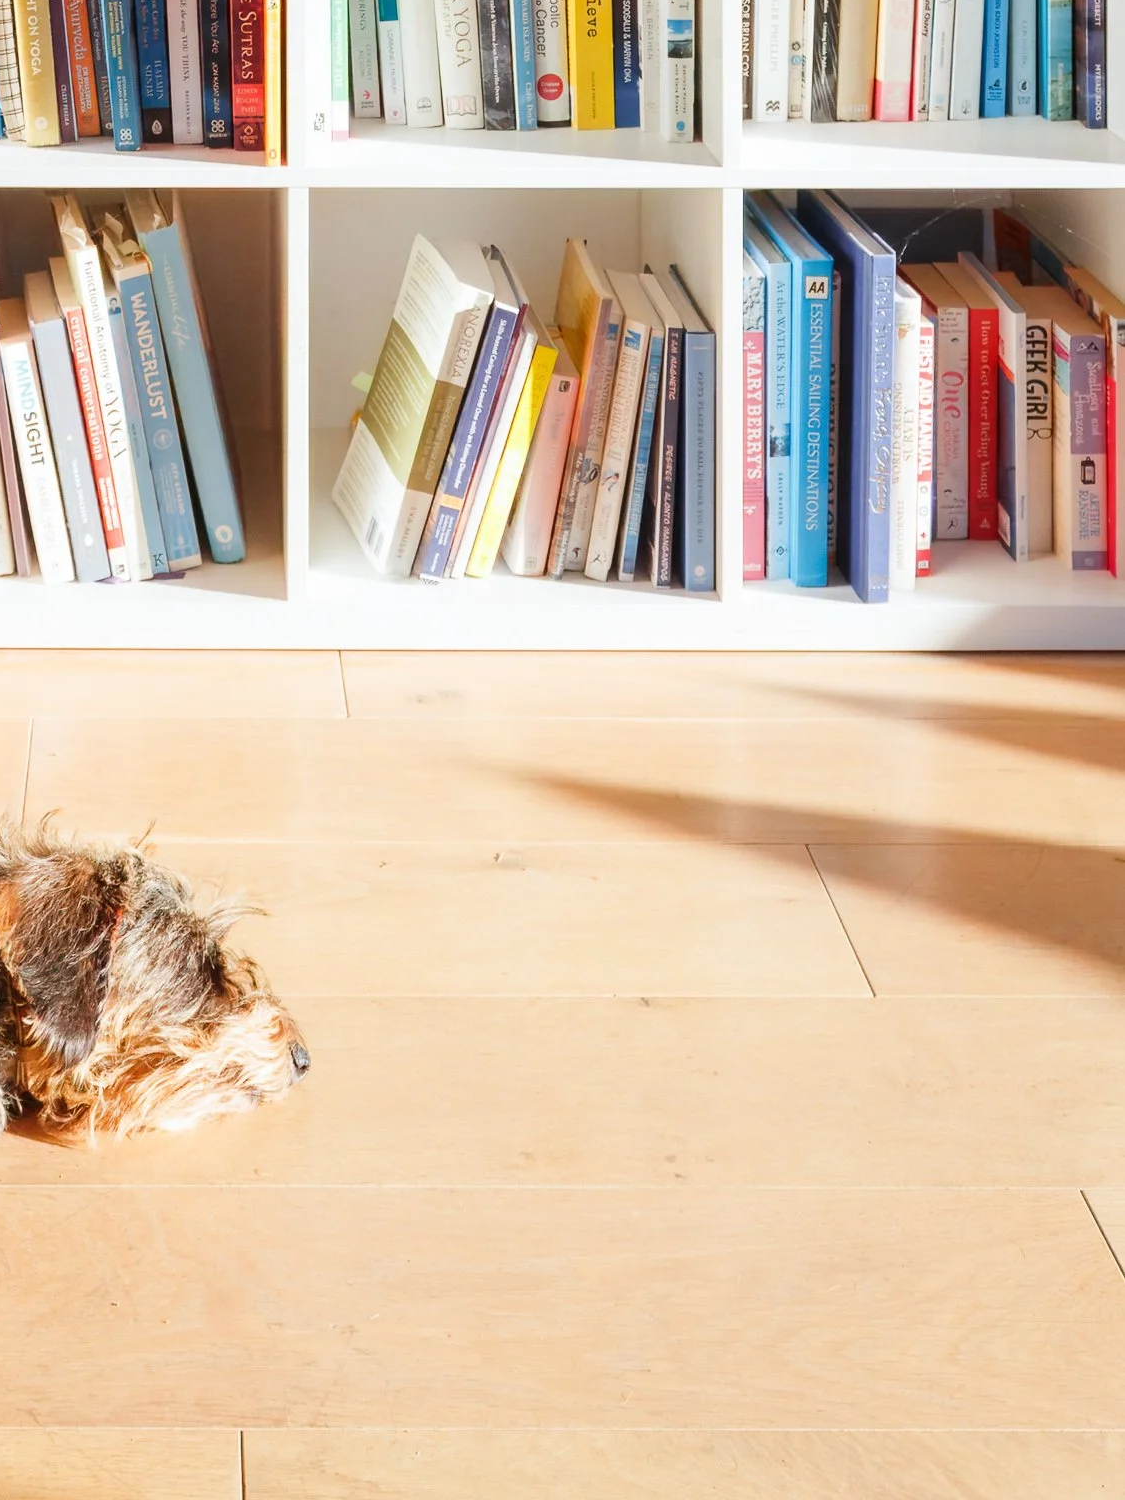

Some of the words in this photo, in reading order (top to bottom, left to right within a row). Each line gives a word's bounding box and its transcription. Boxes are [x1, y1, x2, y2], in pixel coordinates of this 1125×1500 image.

[27, 15, 38, 35] ON
[453, 10, 472, 68] YOGA
[535, 9, 549, 57] Cancer
[29, 38, 42, 76] YOGA
[70, 315, 88, 364] crucial
[130, 291, 167, 421] WANDERLUST
[450, 303, 483, 380] ANOREXIA
[807, 303, 823, 373] ESSENTIAL
[746, 352, 762, 401] MARY
[807, 374, 823, 429] SAILING
[78, 367, 103, 461] conversations
[746, 404, 762, 479] BERRY'S
[805, 432, 820, 531] DESTINATIONS
